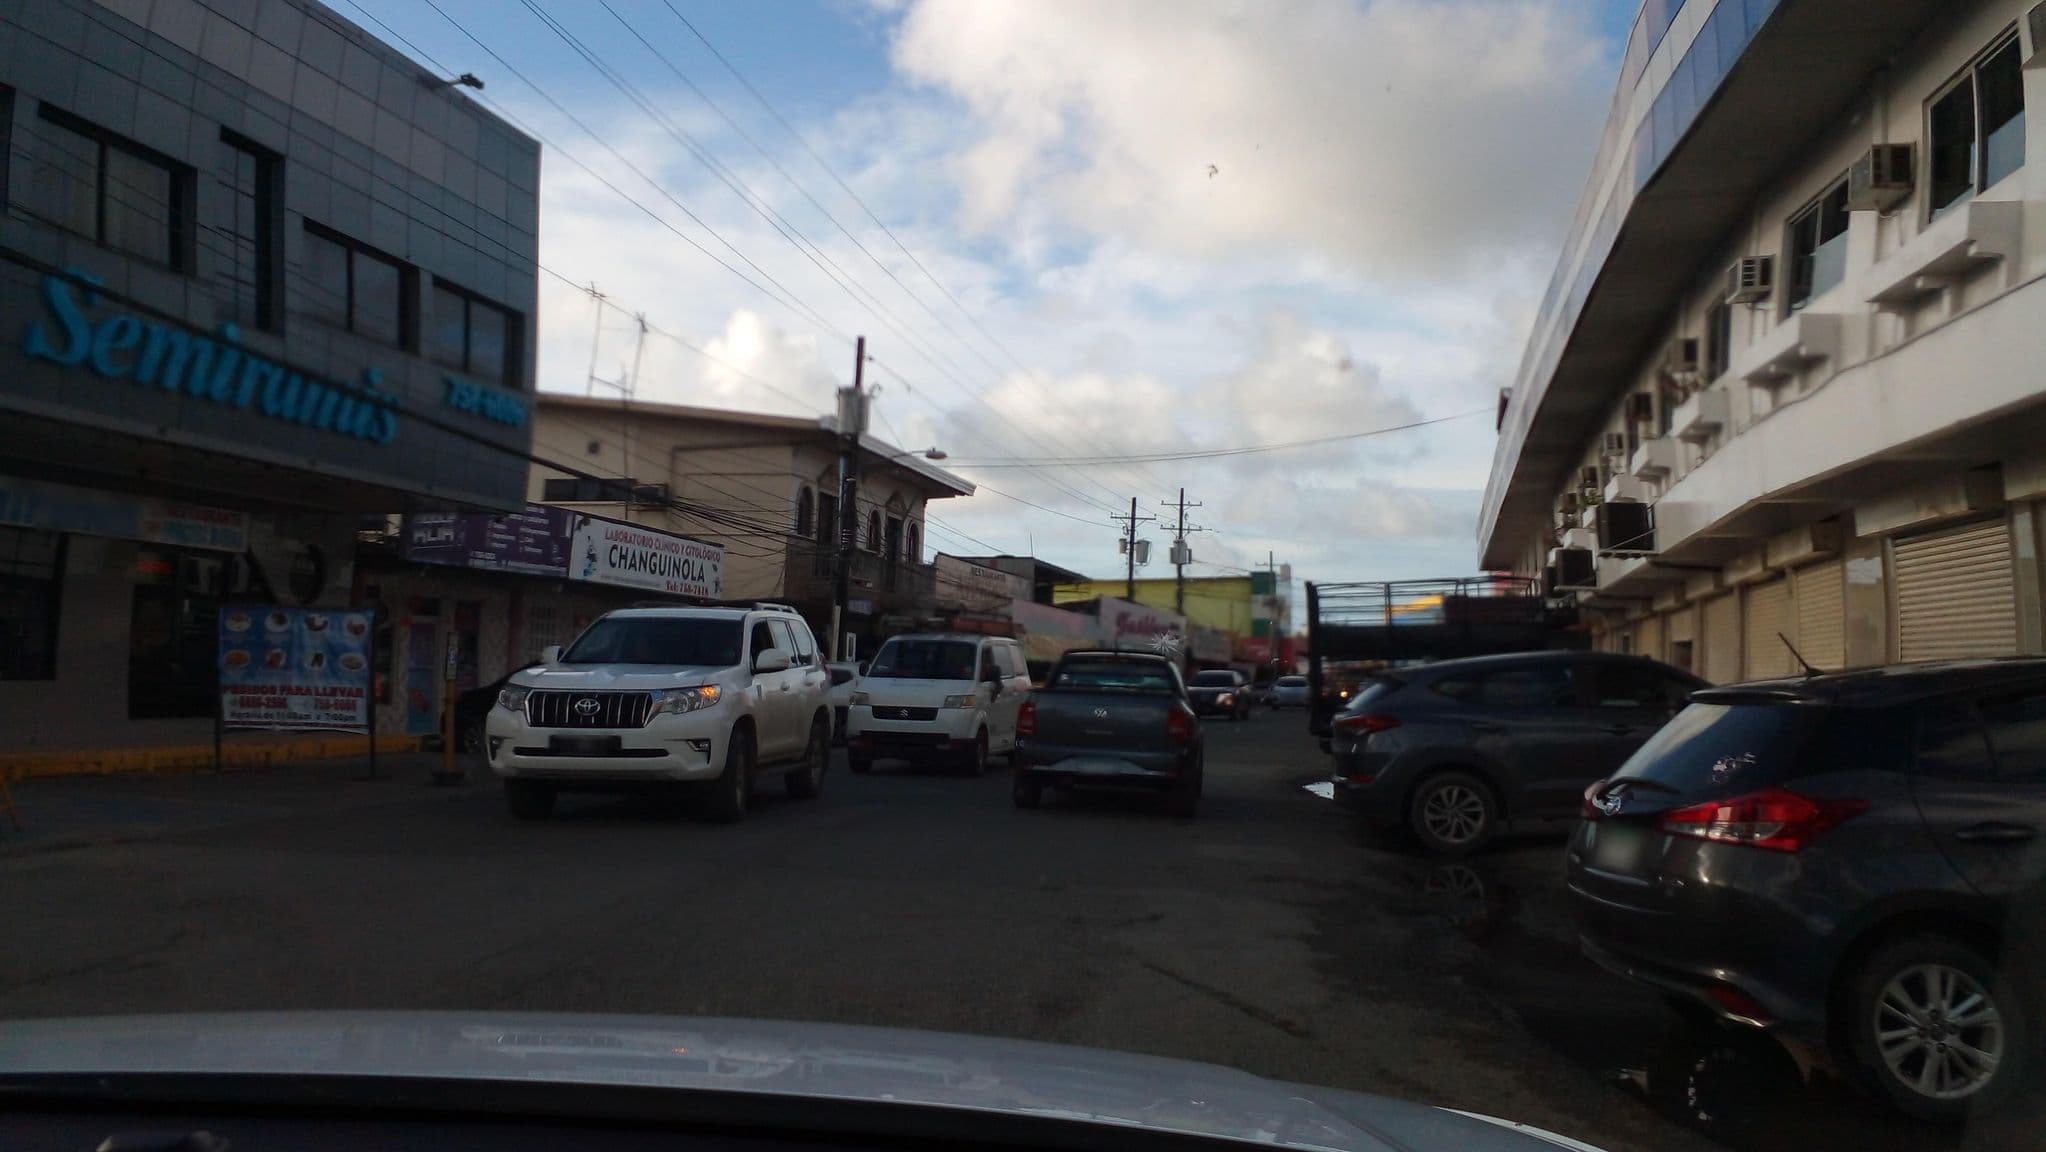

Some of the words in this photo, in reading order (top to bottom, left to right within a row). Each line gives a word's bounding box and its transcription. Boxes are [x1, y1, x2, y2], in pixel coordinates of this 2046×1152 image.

[24, 263, 398, 444] Semiramis
[604, 527, 654, 548] LABORATORIO
[684, 543, 721, 563] CITOLÓGICO
[608, 544, 706, 583] CHANGUINOLA
[280, 685, 312, 696] PARA
